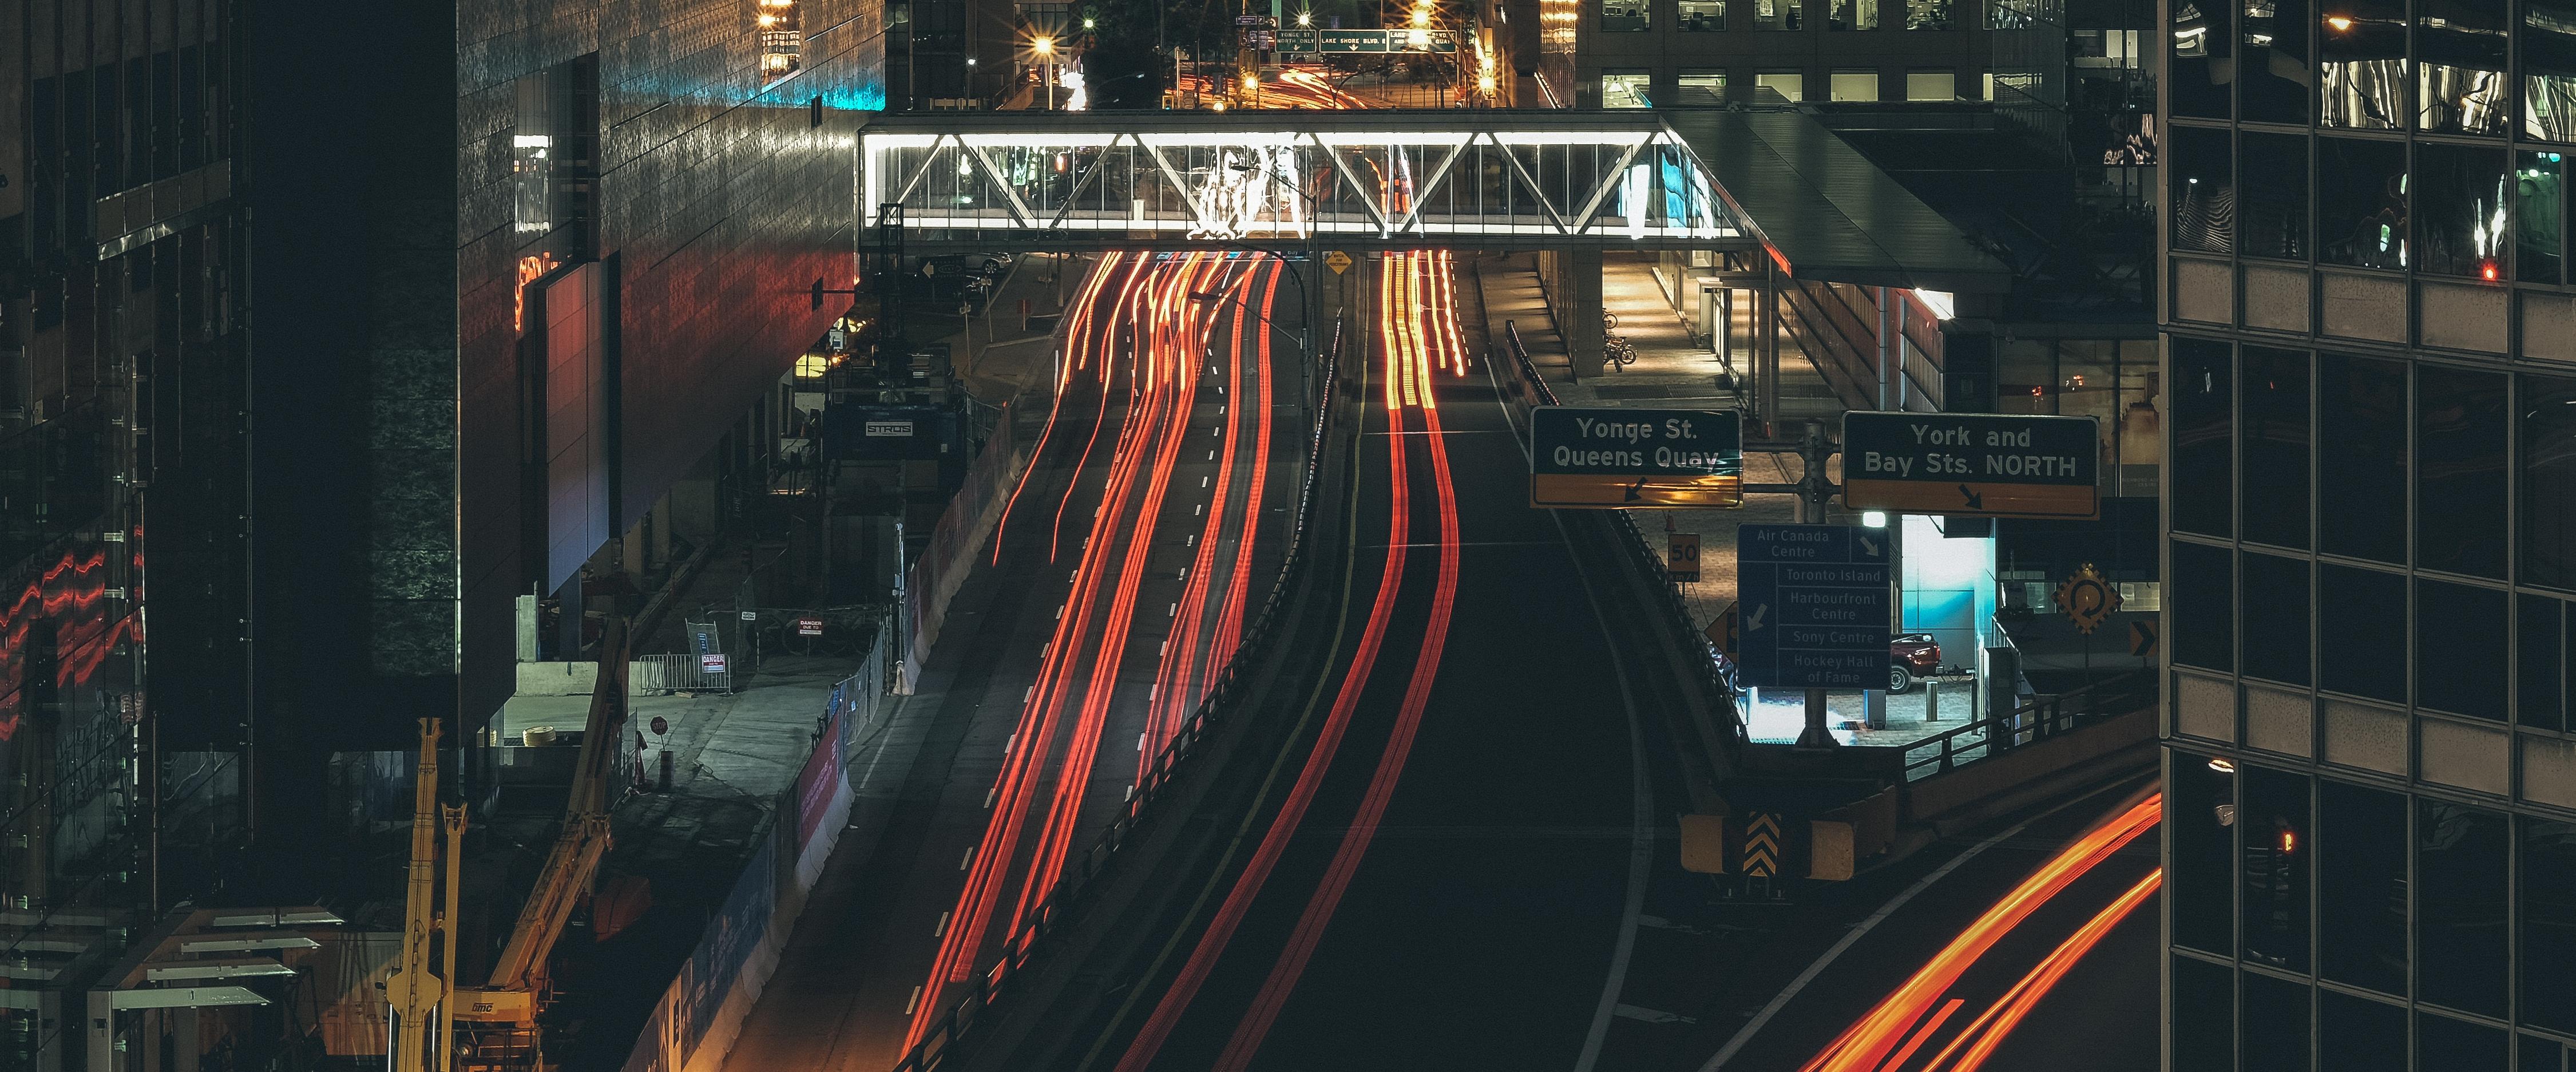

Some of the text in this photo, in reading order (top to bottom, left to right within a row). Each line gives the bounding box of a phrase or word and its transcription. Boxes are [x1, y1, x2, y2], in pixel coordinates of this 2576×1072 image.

[867, 425, 911, 433] STROS
[1576, 418, 1697, 445] Yonge St.
[1911, 424, 2030, 447] York and
[1554, 445, 1719, 474] Queens Quay
[1865, 452, 2076, 477] Bay Sts. NORTH
[1757, 530, 1829, 542] Air Canada
[1672, 544, 1698, 561] 50
[1772, 545, 1816, 558] Centre
[1786, 568, 1881, 582] Toronto Island
[1791, 592, 1876, 605] Harbourfront
[1812, 608, 1856, 620] Centre
[1793, 631, 1874, 645] Sony Centre
[1794, 654, 1874, 669] Hockey Hall
[1808, 671, 1860, 683] of Fame
[653, 721, 666, 730] STOP
